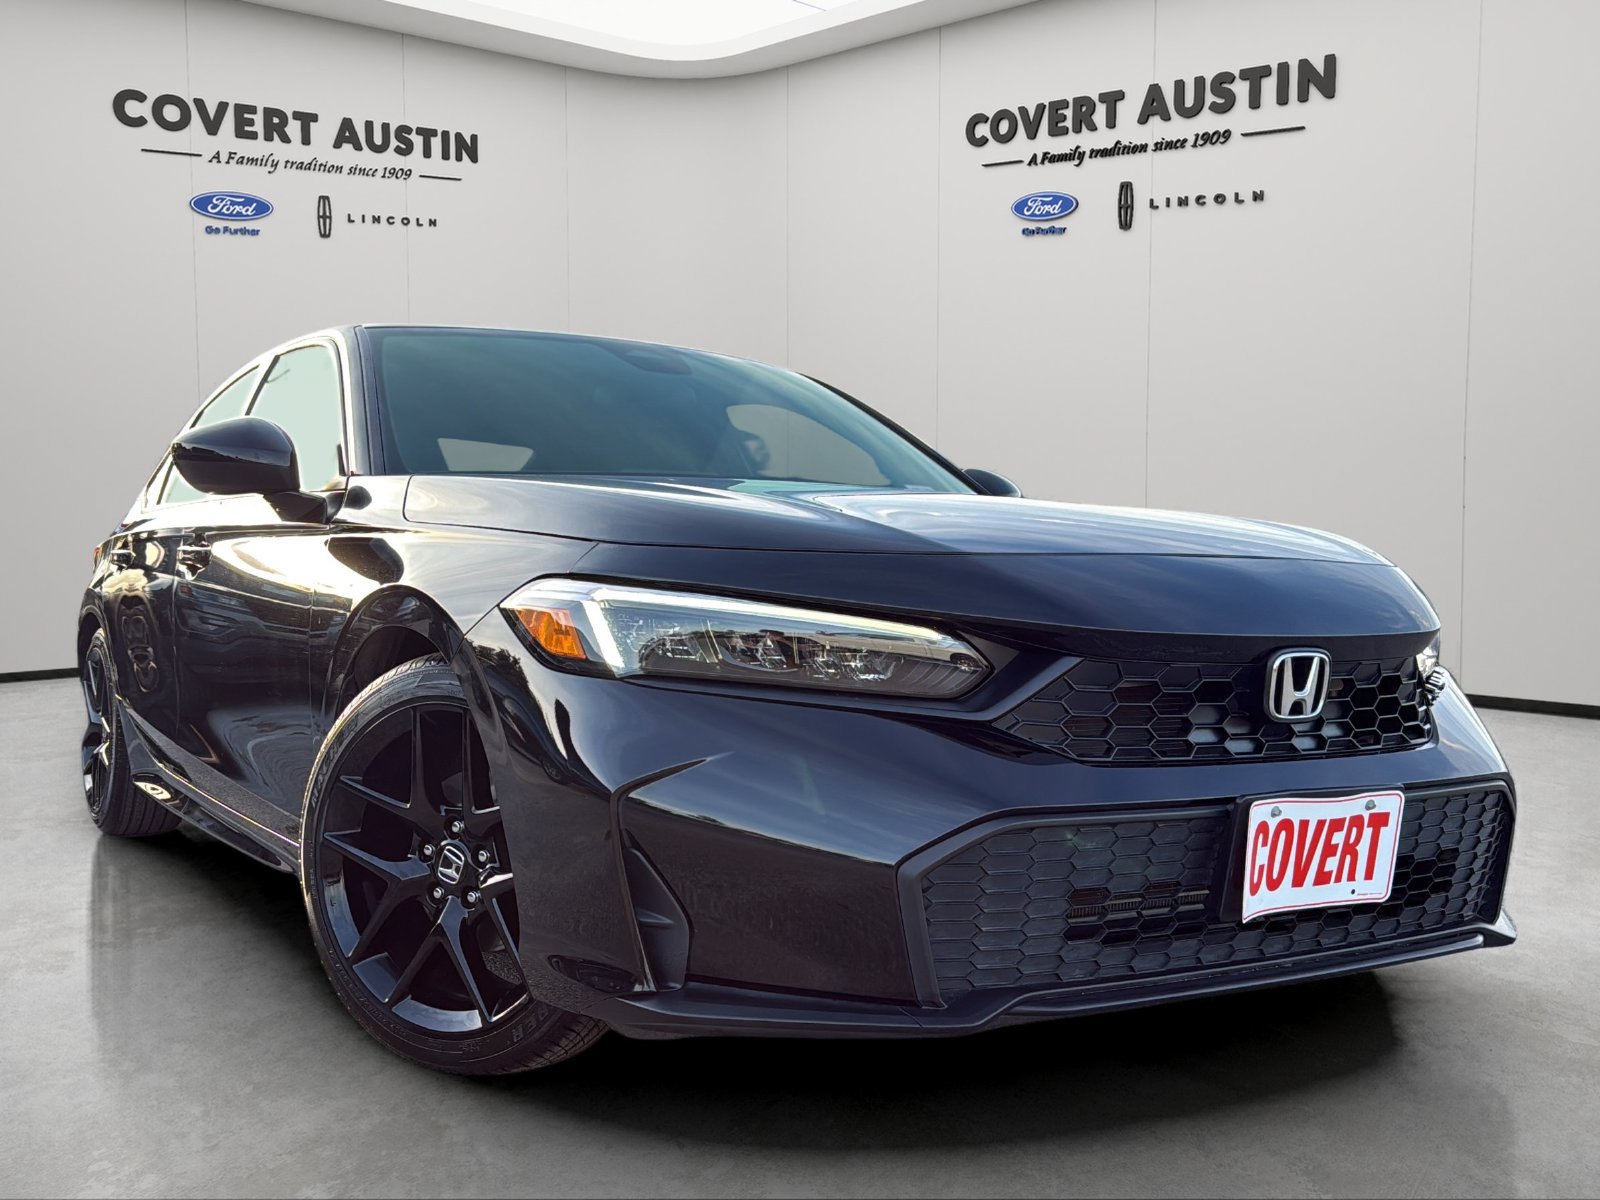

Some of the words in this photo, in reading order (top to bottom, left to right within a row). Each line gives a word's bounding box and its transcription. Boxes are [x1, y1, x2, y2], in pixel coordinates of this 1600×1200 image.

[965, 89, 1125, 147] COVERT
[1137, 53, 1337, 125] AUSTIN
[112, 88, 319, 146] COVERT
[332, 117, 479, 164] AUSTIN
[1027, 153, 1039, 166] A
[1039, 145, 1087, 167] Family
[1088, 139, 1149, 159] tradition
[1151, 137, 1188, 152] since
[1191, 129, 1232, 149] 1909
[208, 150, 222, 164] A
[225, 151, 280, 174] Family
[284, 157, 344, 174] tradition
[347, 164, 378, 178] since
[381, 166, 413, 181] 1909
[207, 195, 257, 215] Ford
[1023, 196, 1063, 215] Ford
[1149, 190, 1265, 210] LINCOLN
[205, 225, 221, 234] Go
[222, 226, 261, 236] Further
[347, 213, 437, 228] LINCOLN
[1250, 811, 1391, 897] COVERT
